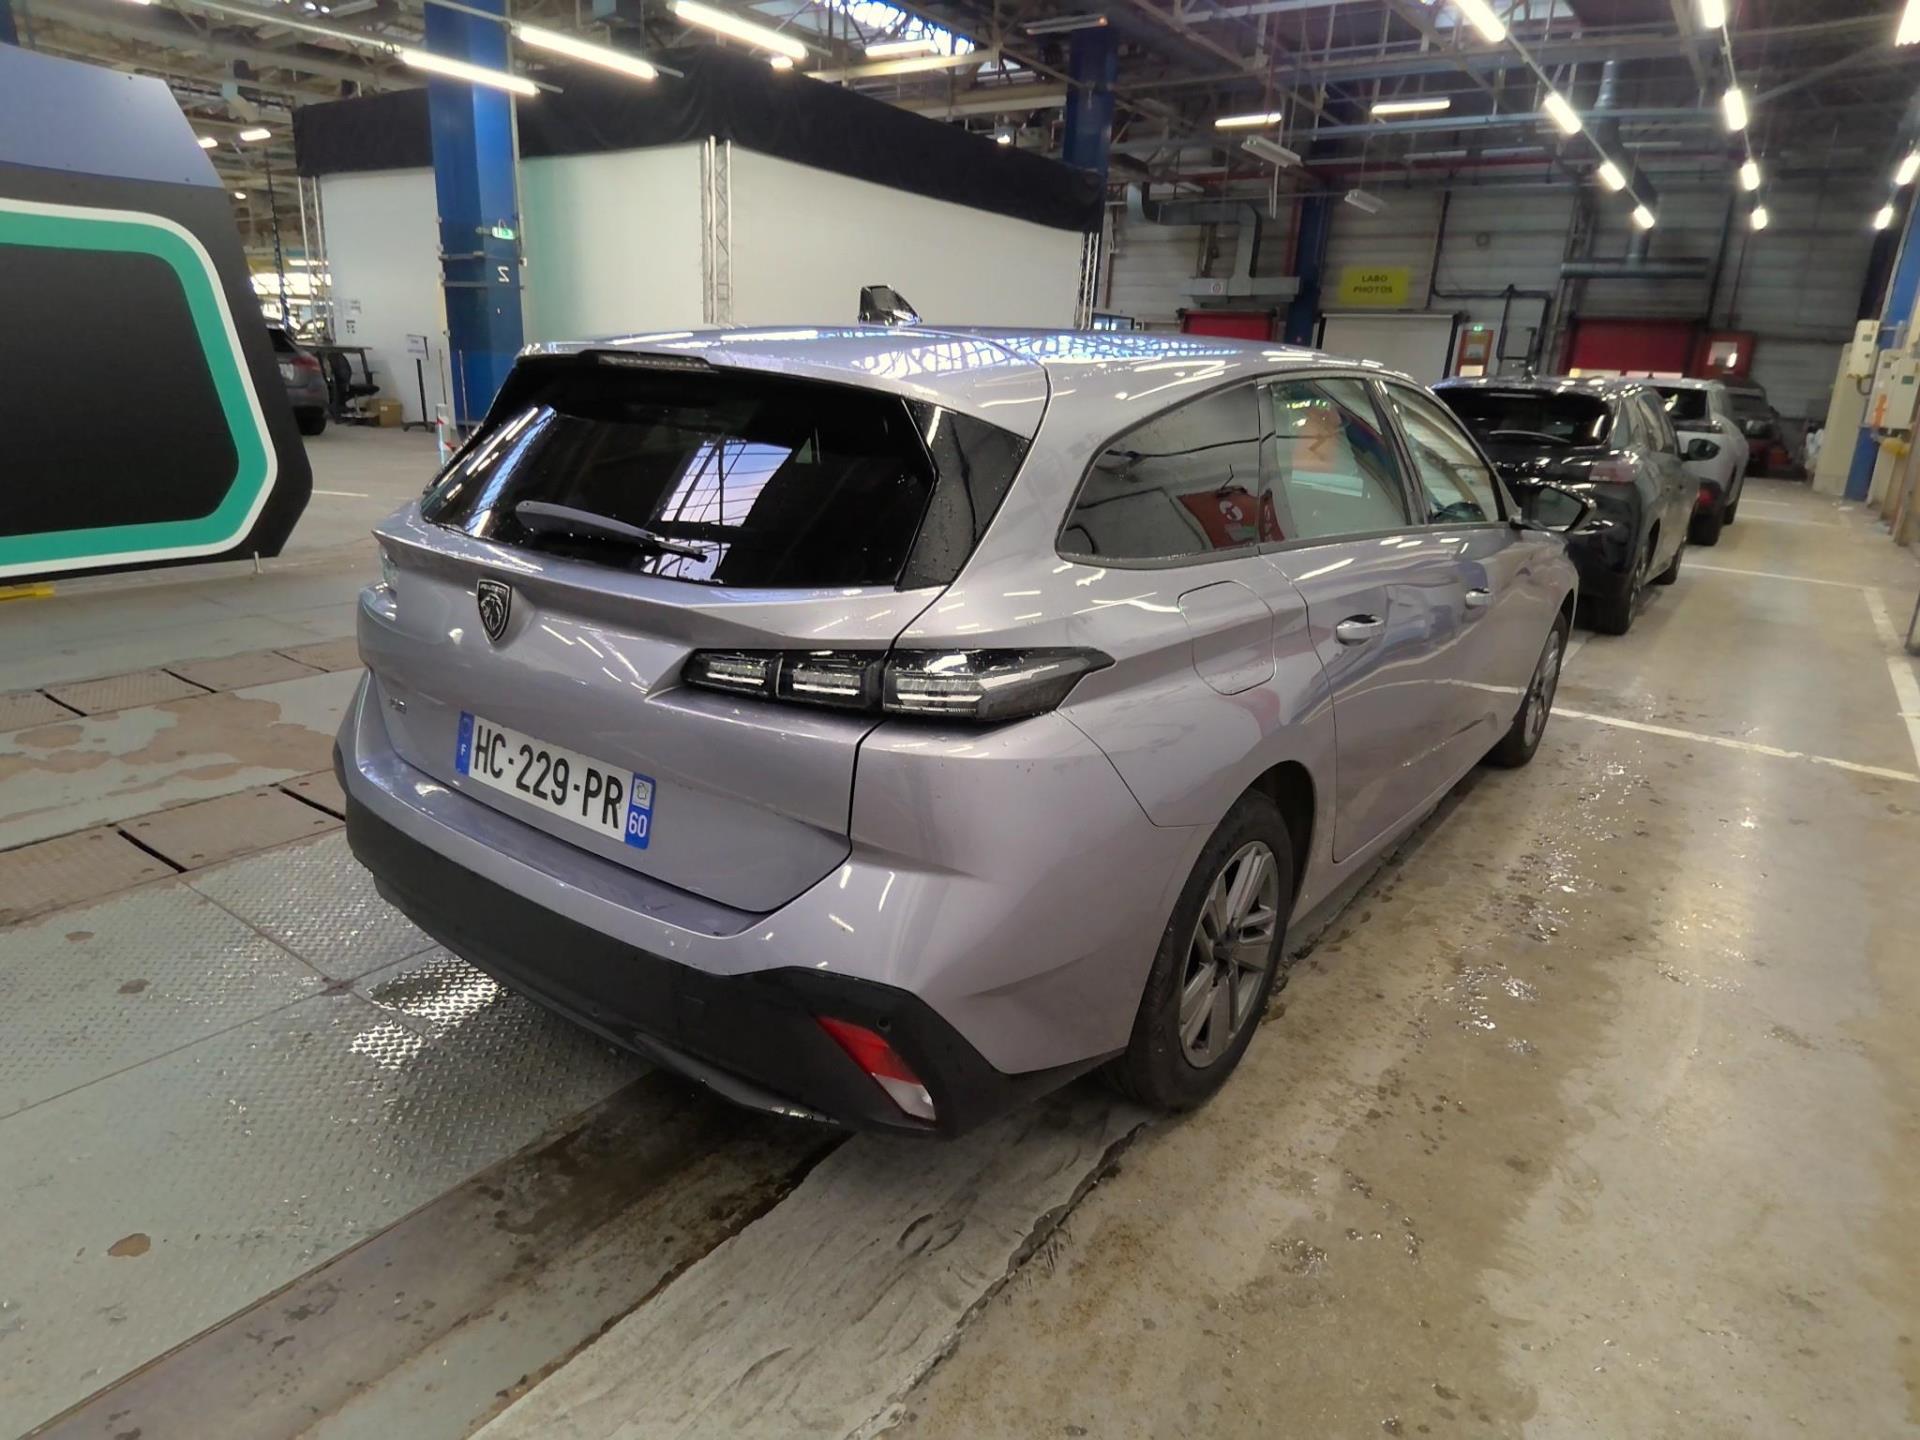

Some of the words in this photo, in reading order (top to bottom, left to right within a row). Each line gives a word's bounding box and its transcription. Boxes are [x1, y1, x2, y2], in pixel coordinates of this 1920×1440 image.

[1361, 274, 1388, 283] LABO
[461, 744, 467, 756] F
[474, 725, 623, 829] HC-229-PR
[628, 811, 648, 838] 60
